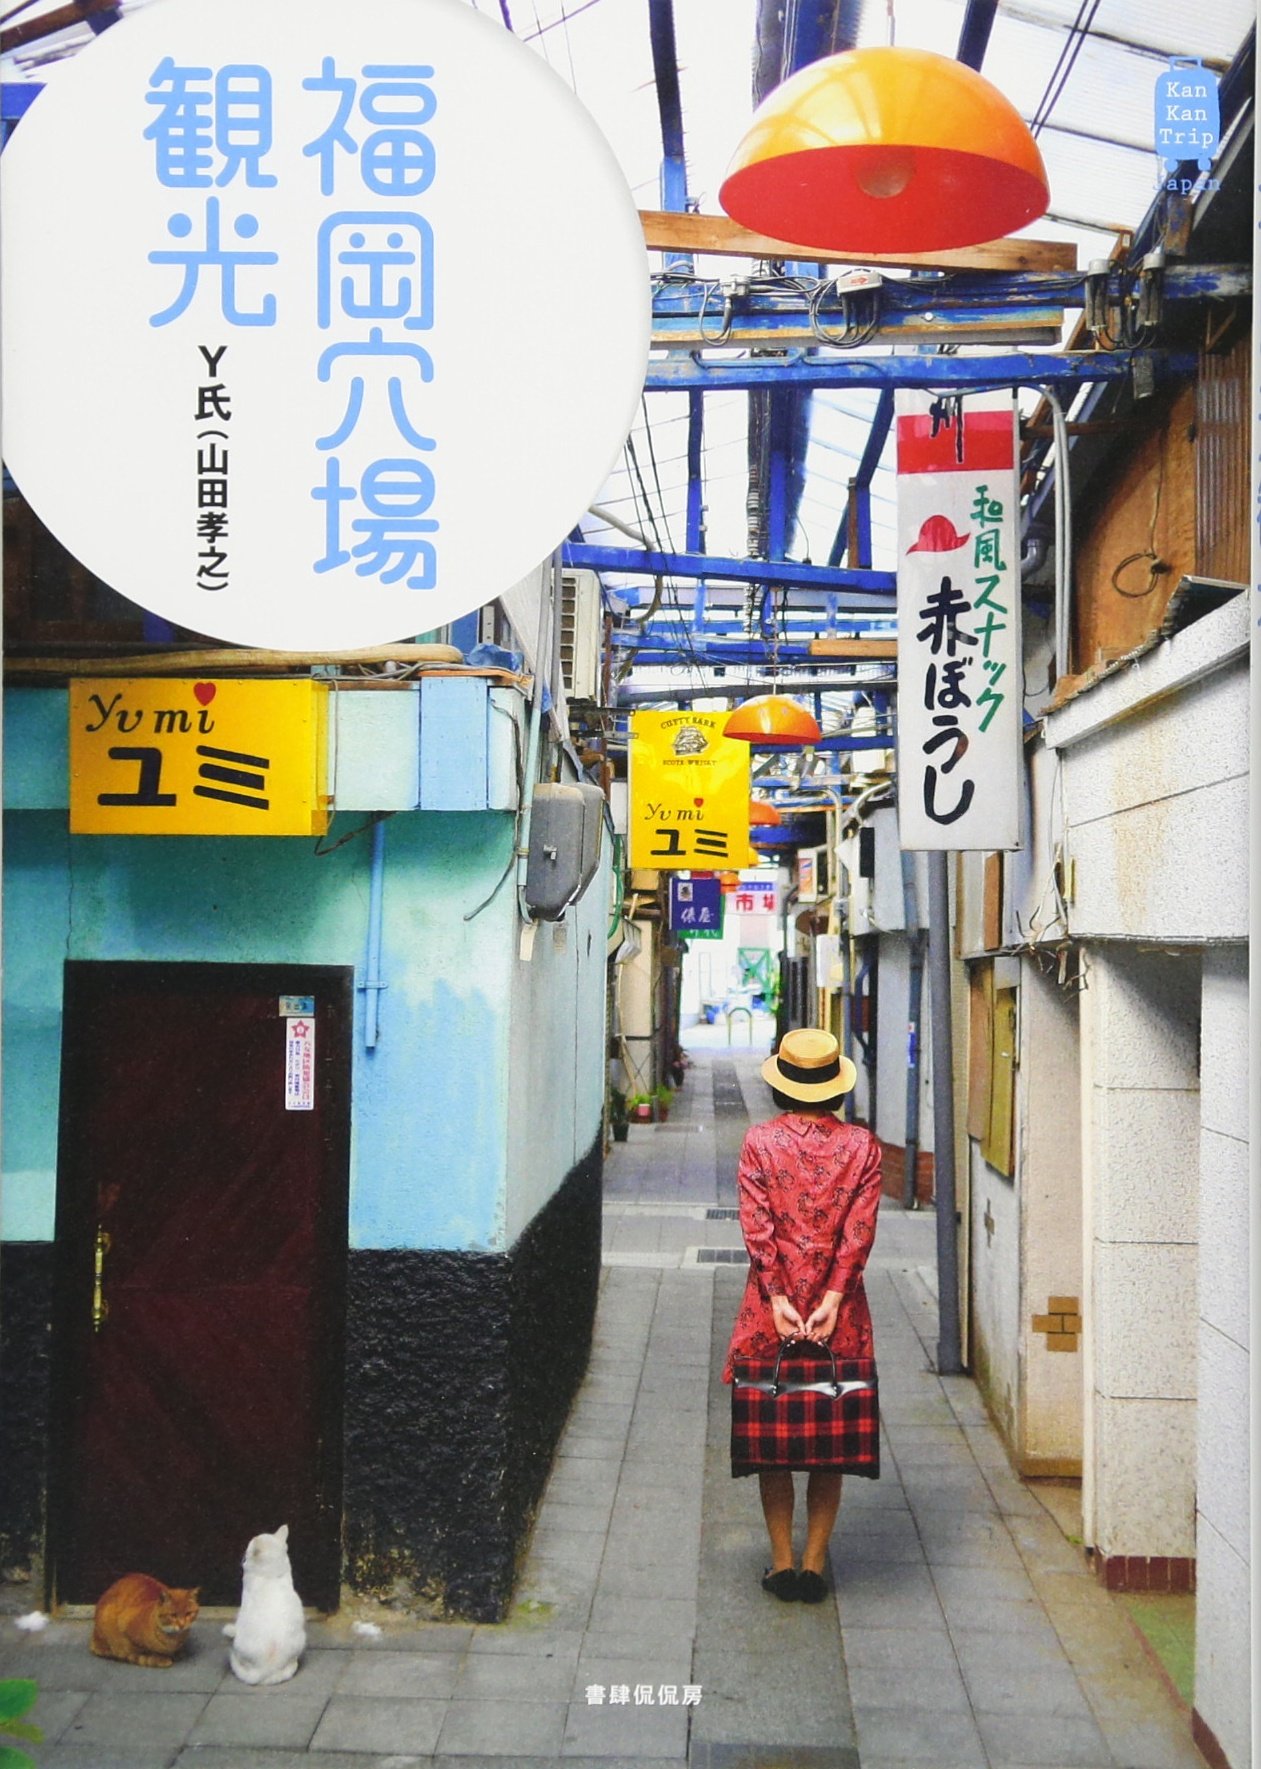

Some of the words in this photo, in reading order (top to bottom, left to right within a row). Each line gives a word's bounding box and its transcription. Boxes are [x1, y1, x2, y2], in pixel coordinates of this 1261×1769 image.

[970, 484, 1008, 733] 和風スナック
[97, 745, 270, 810] ユミ
[916, 576, 979, 825] 赤ぼうし
[650, 829, 729, 858] ユミ
